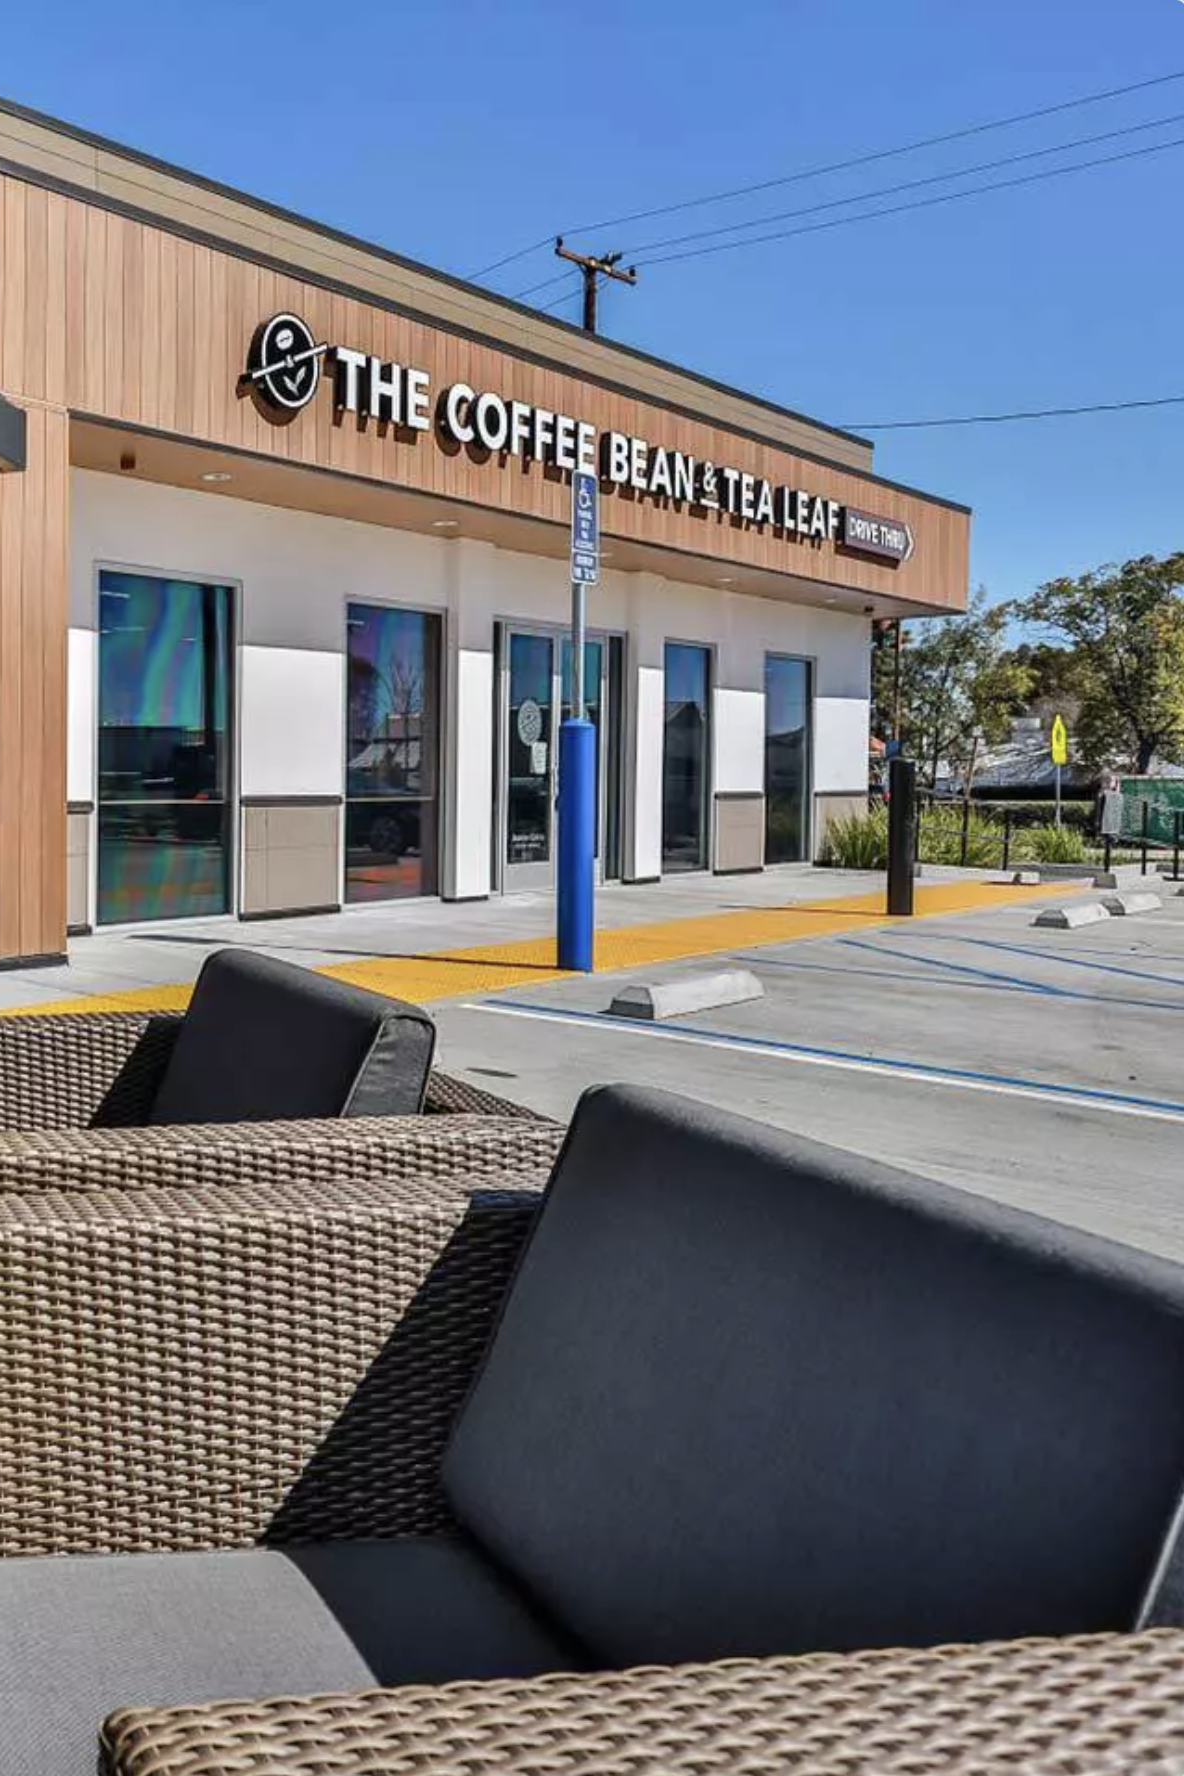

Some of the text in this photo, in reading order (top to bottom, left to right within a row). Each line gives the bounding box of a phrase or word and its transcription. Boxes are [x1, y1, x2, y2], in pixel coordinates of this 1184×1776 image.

[336, 346, 840, 540] THE COFFEE BEAN & TEA LEAF
[849, 516, 905, 552] DRIVE THRU
